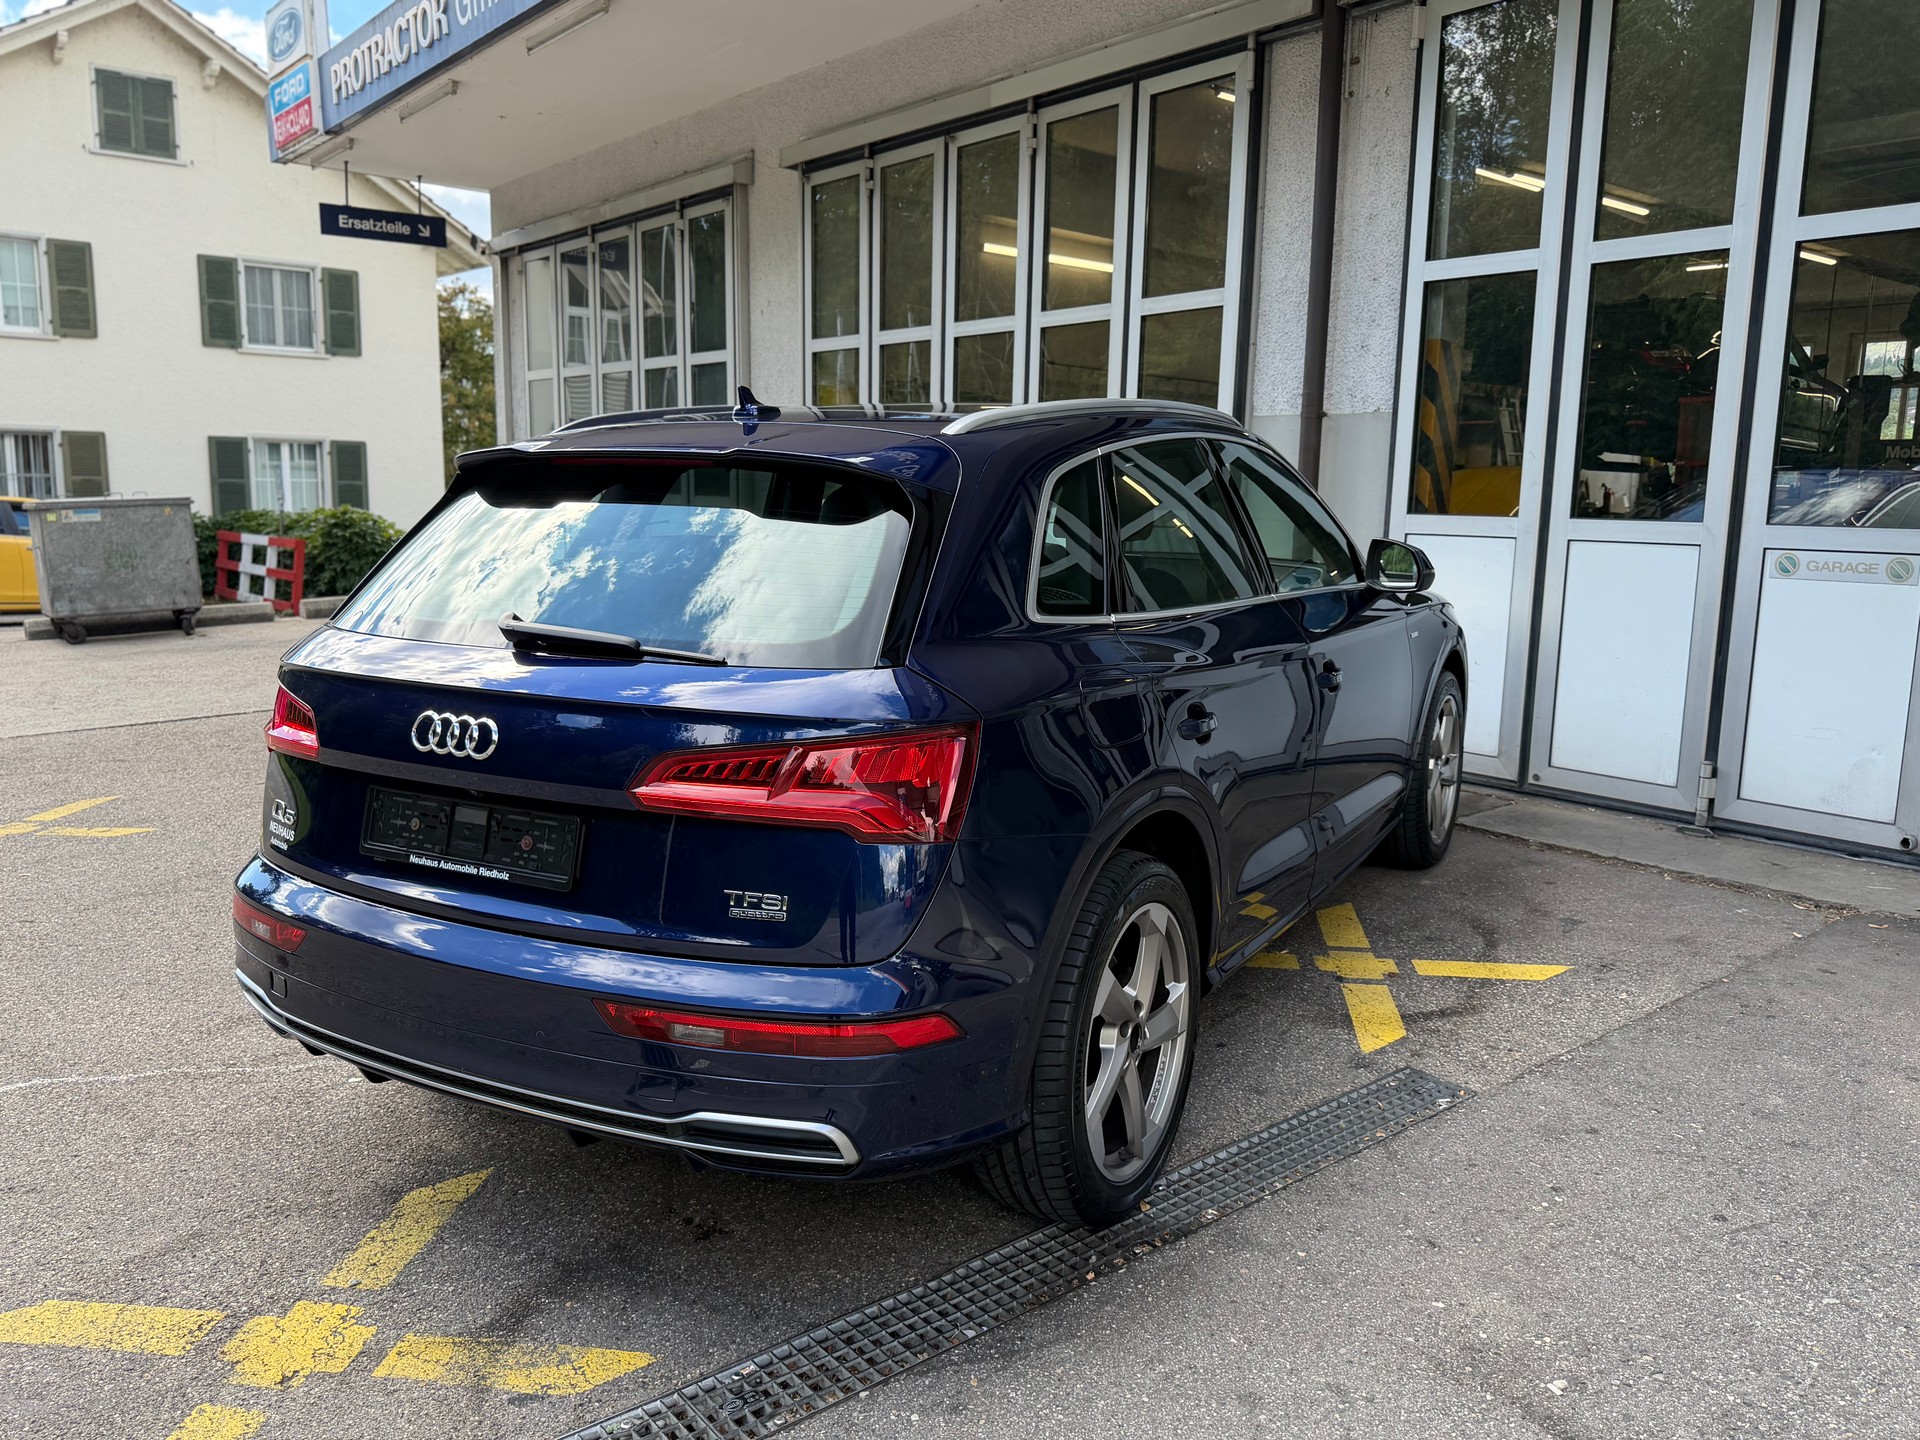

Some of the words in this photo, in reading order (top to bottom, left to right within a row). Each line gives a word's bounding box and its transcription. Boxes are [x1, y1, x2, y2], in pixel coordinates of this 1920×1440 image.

[330, 0, 449, 105] PROTRACTOR
[273, 72, 305, 107] FORD
[338, 214, 411, 235] Ersatzteile
[1806, 560, 1880, 574] GARAGE
[272, 799, 296, 825] Q5
[270, 820, 295, 841] NEUHAUS
[409, 854, 438, 867] Neuhaus
[439, 860, 478, 875] Automobile
[479, 867, 509, 880] Riedholz
[723, 889, 788, 911] TFSI
[731, 910, 784, 920] quattro
[1075, 1031, 1085, 1117] KUMHO
